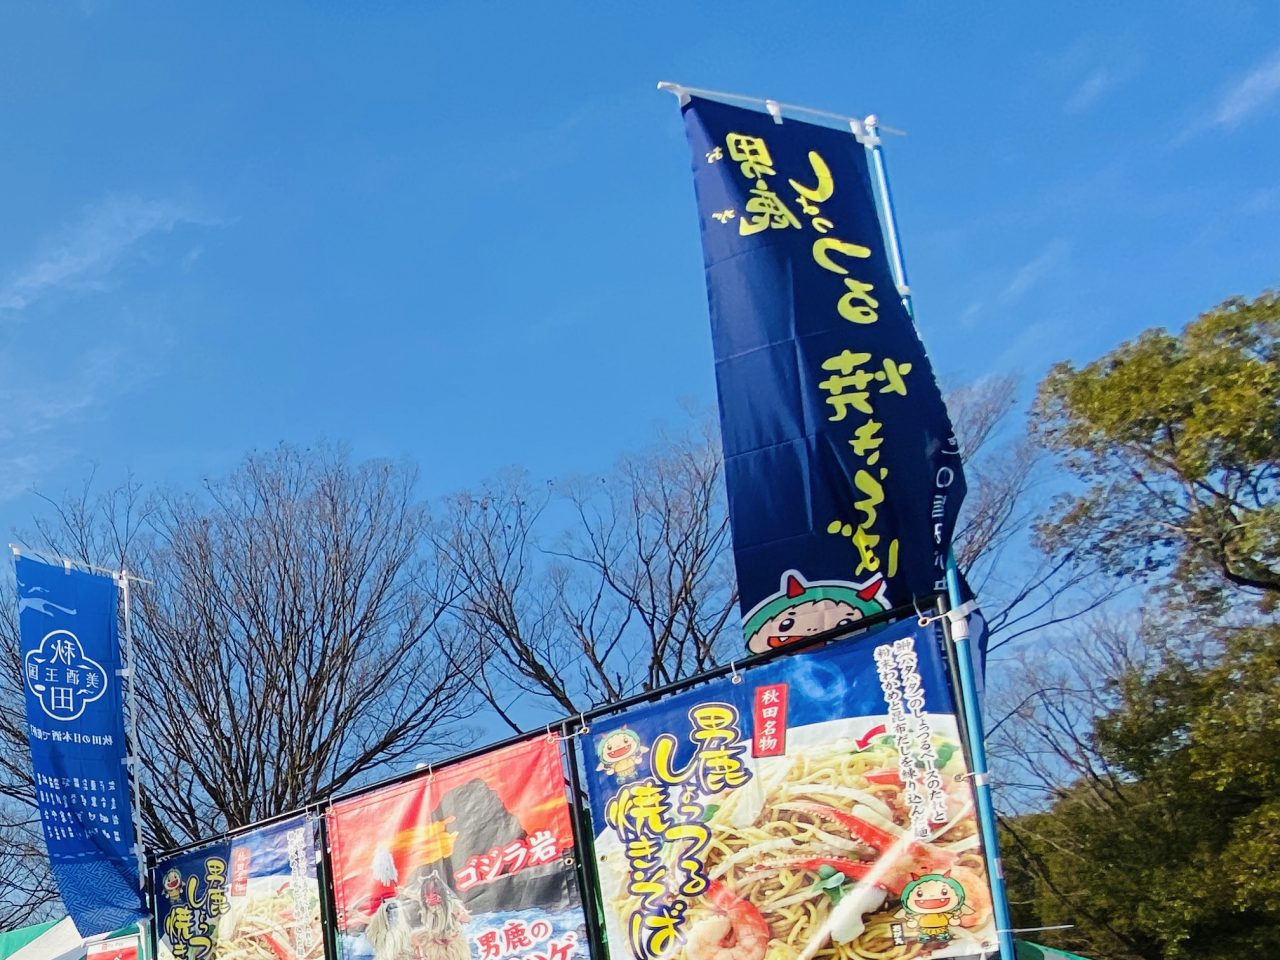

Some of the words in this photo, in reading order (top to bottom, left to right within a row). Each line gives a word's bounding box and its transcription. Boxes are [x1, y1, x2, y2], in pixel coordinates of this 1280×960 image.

[689, 703, 753, 792] 男鹿
[759, 688, 779, 752] 秋田名物
[651, 737, 711, 896] しょっつる
[205, 857, 231, 918] 男鹿
[456, 830, 558, 891] ゴジラ岩
[477, 921, 549, 960] 男鹿の
